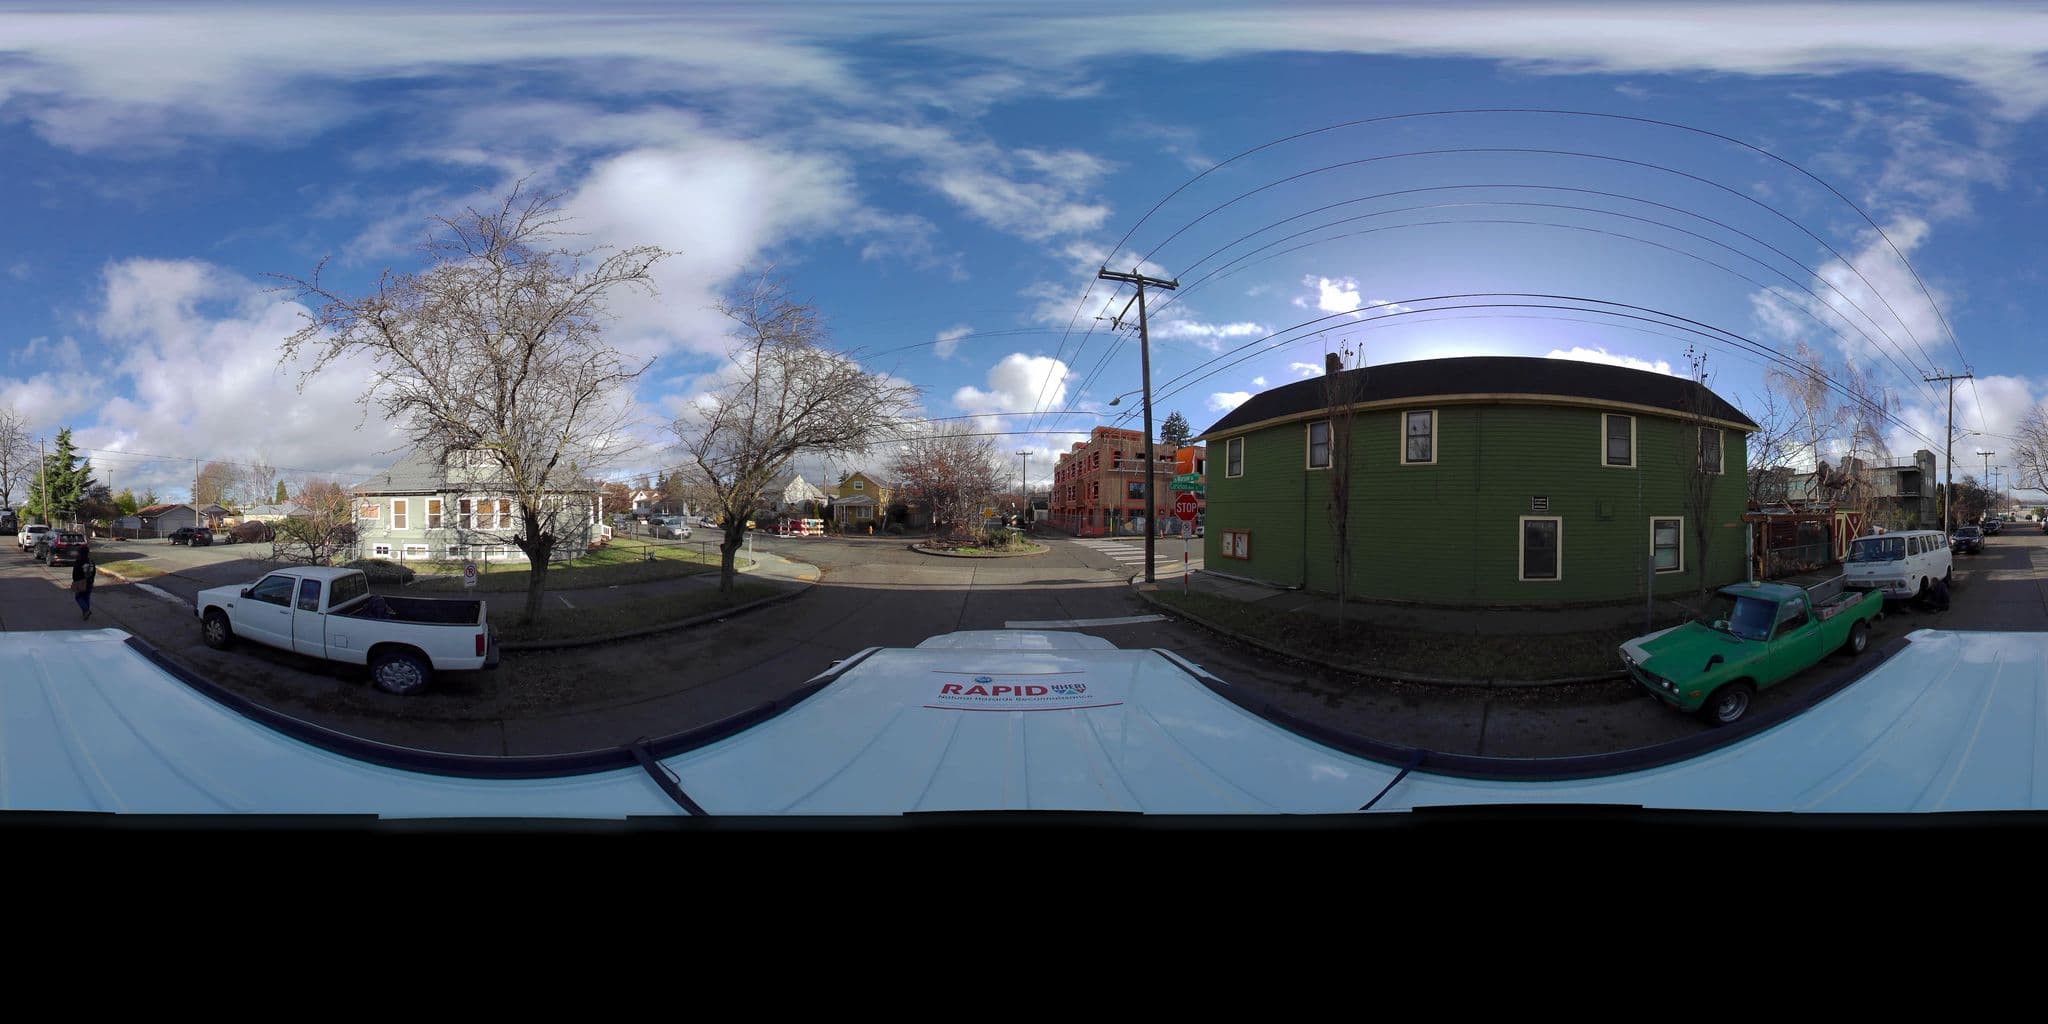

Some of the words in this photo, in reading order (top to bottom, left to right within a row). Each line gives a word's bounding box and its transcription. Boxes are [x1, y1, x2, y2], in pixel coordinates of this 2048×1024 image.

[1176, 502, 1196, 512] STOP
[941, 684, 1048, 696] RAPID
[1051, 683, 1087, 691] NHERI
